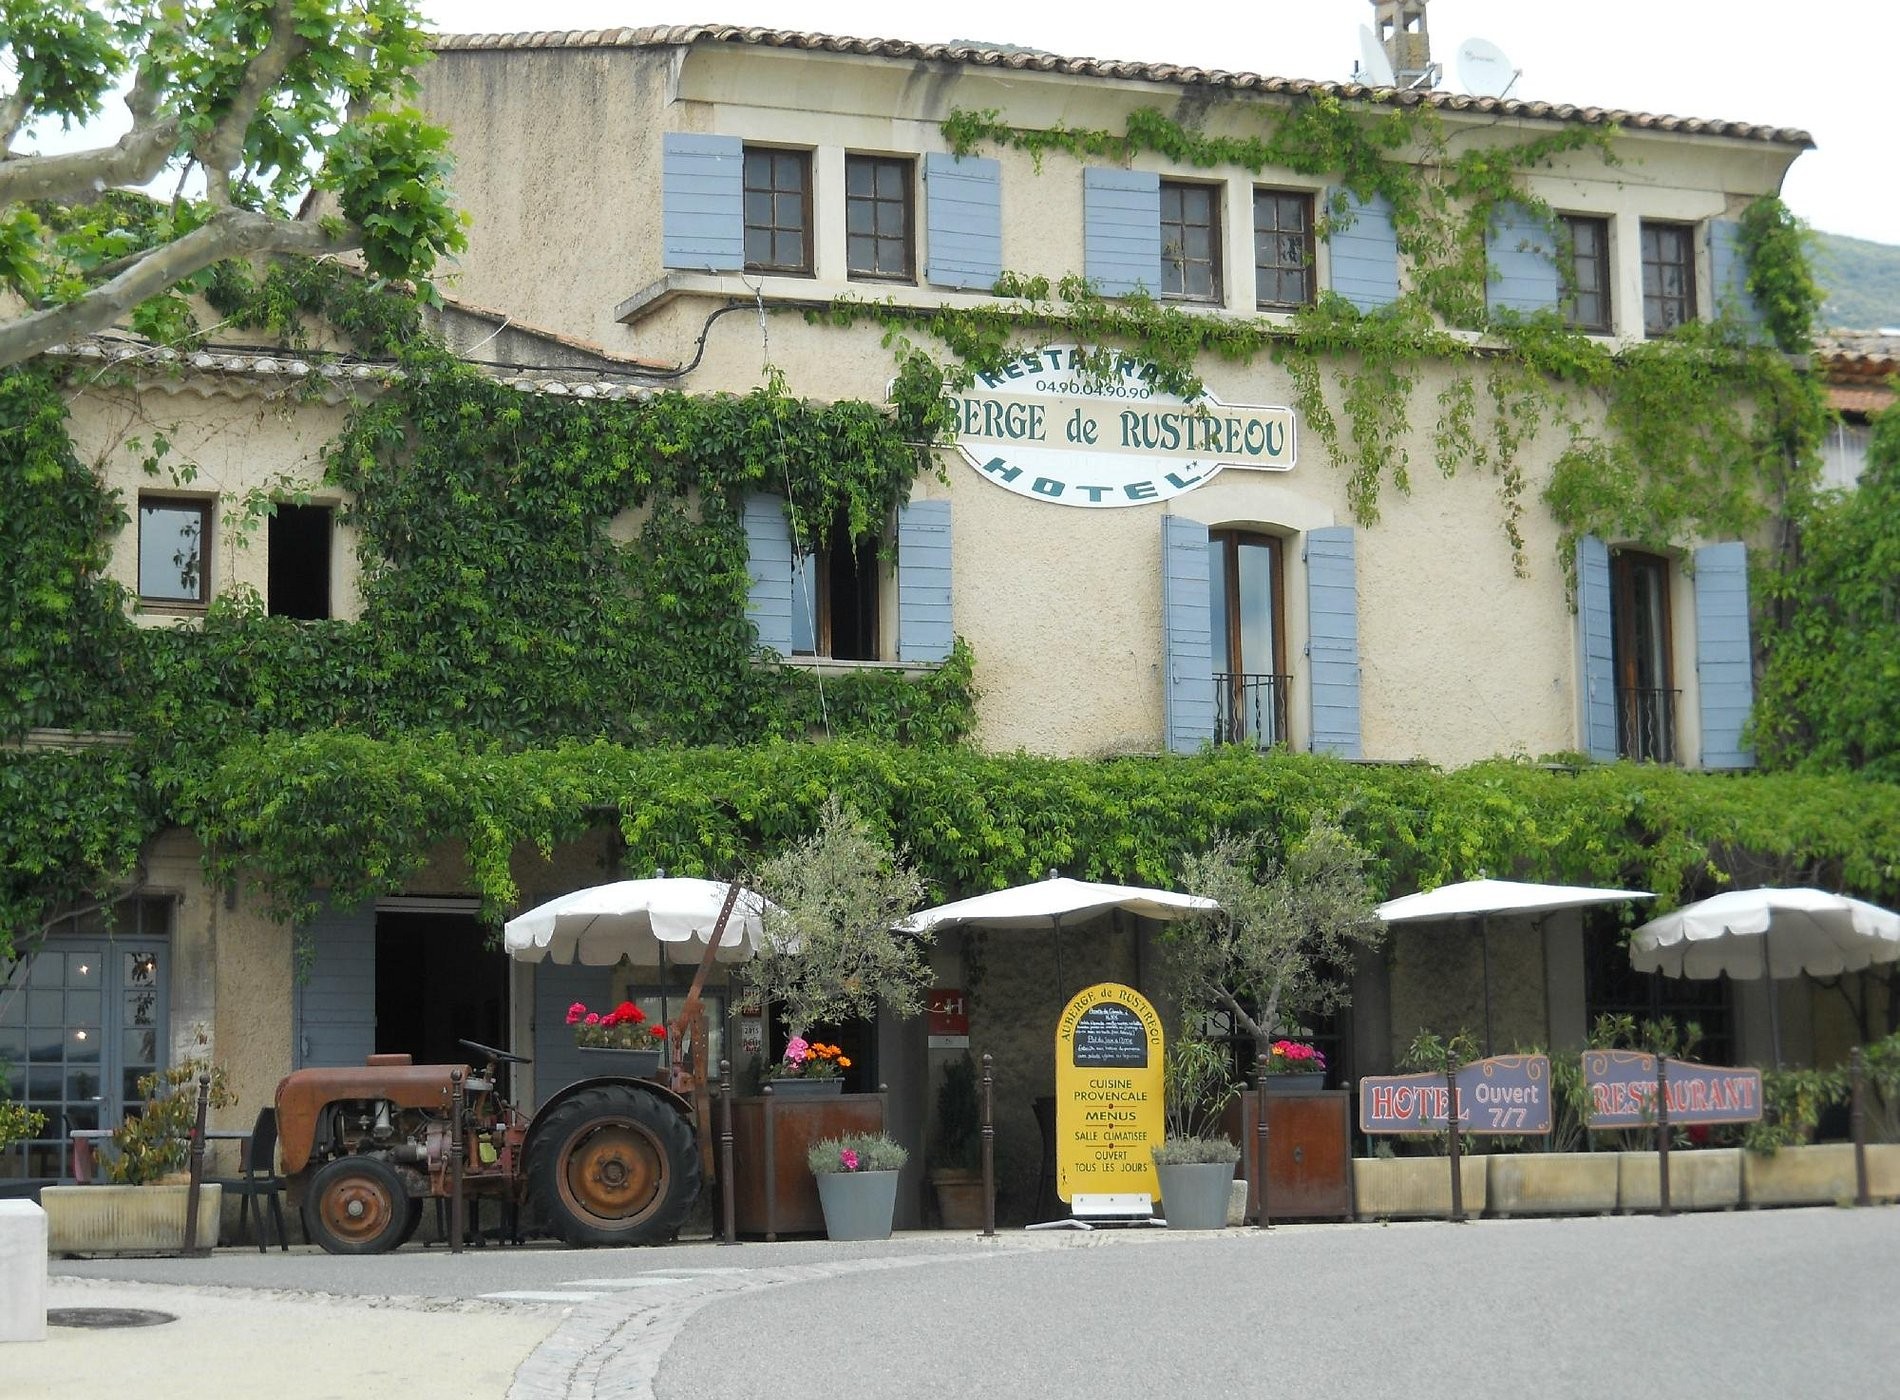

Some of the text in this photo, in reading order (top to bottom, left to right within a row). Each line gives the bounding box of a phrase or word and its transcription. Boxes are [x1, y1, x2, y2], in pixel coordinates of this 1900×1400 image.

[977, 349, 1208, 405] RESTARA
[1035, 379, 1150, 400] 04.90.04.90.90
[942, 396, 1284, 457] BERGE de RUSTREOU
[982, 456, 1202, 502] HOTEL
[1061, 987, 1160, 1045] AUBERGE de RUSTREOU
[1089, 1079, 1132, 1089] CUISINE
[1475, 1083, 1540, 1104] Ouvert
[1074, 1091, 1148, 1101] PROVENCALE
[1371, 1086, 1470, 1121] HOTEL
[1592, 1076, 1757, 1117] RESTAURANT
[1085, 1111, 1136, 1120] MENUS
[1488, 1107, 1528, 1128] 7/7
[1074, 1131, 1148, 1141] SALLE CLIMATISEE
[1094, 1151, 1128, 1161] OUVERT
[1075, 1163, 1148, 1172] TOUS LES JOURS
